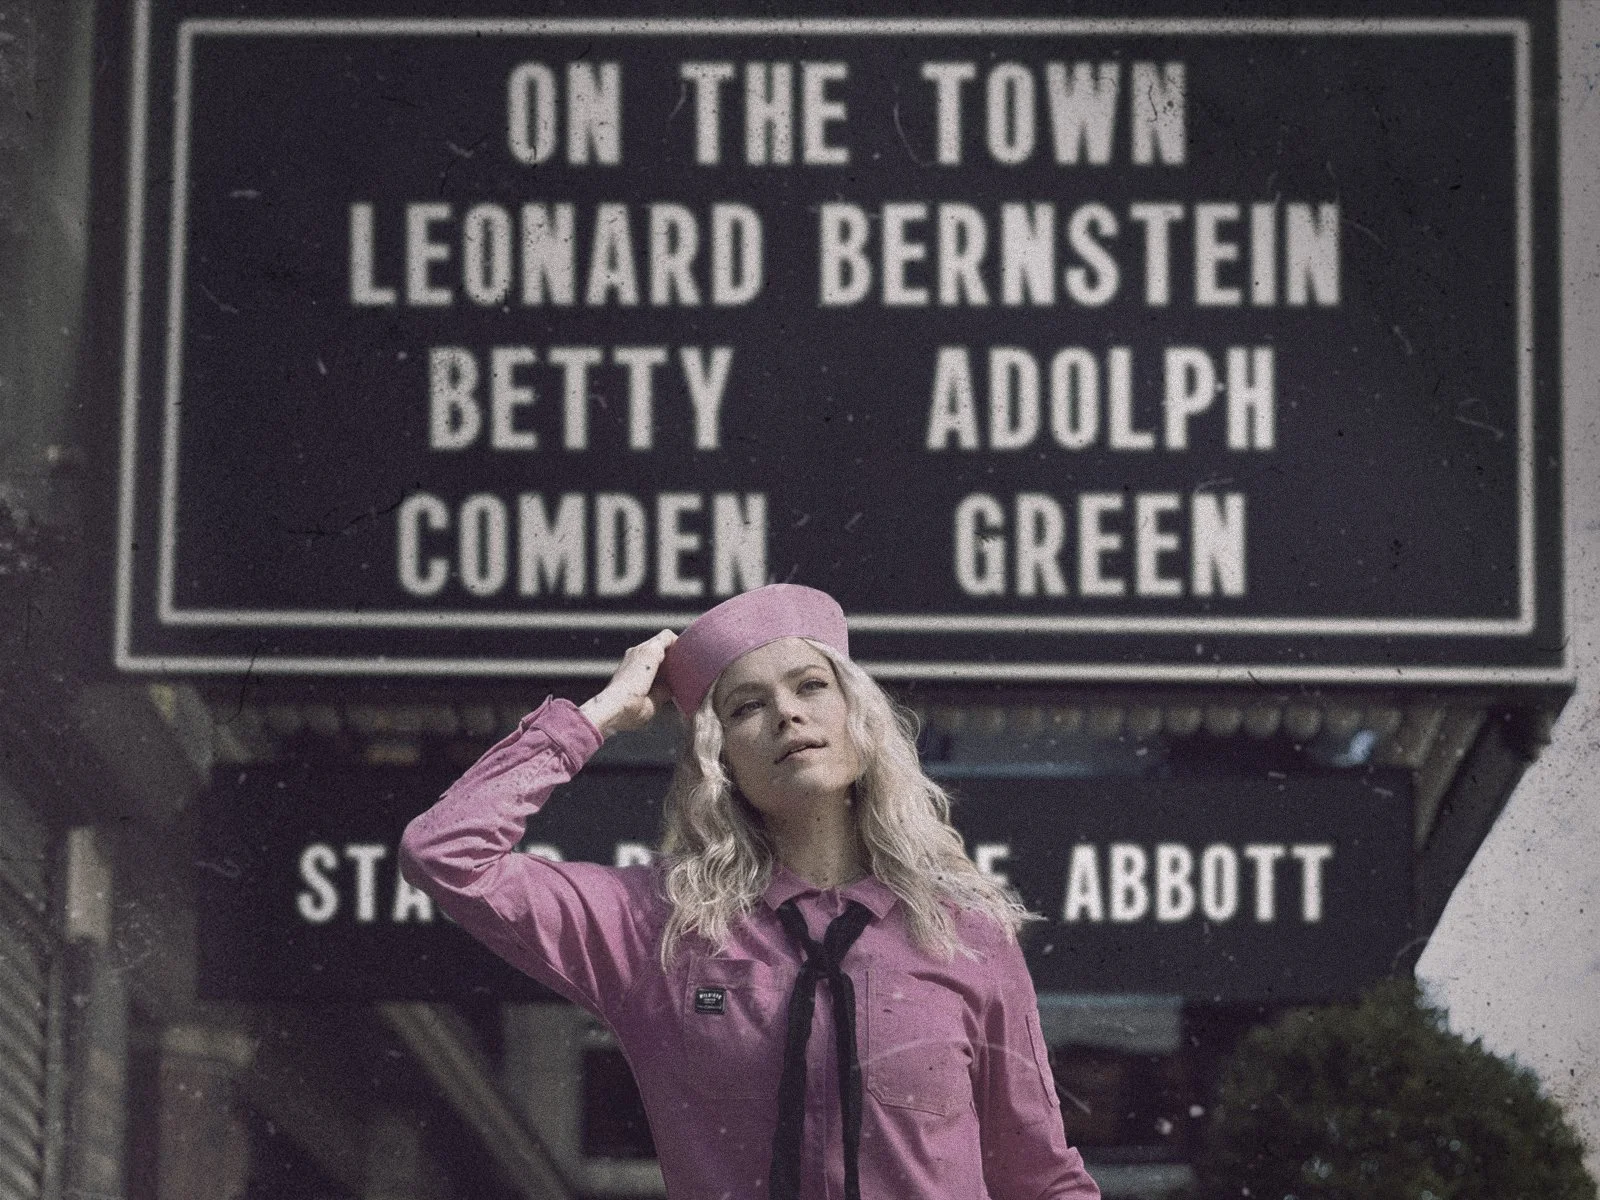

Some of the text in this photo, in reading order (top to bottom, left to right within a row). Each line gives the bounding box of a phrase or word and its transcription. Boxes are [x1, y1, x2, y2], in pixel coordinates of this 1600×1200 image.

[507, 61, 1186, 166] ON THE TOWN
[350, 201, 1341, 307] LEONARD BERNSTEIN
[429, 346, 734, 450] BETTY
[926, 346, 1276, 451] ADOLPH
[398, 493, 766, 596] COMDEN
[954, 491, 1247, 597] GREEN
[1063, 843, 1333, 922] ABBOTT
